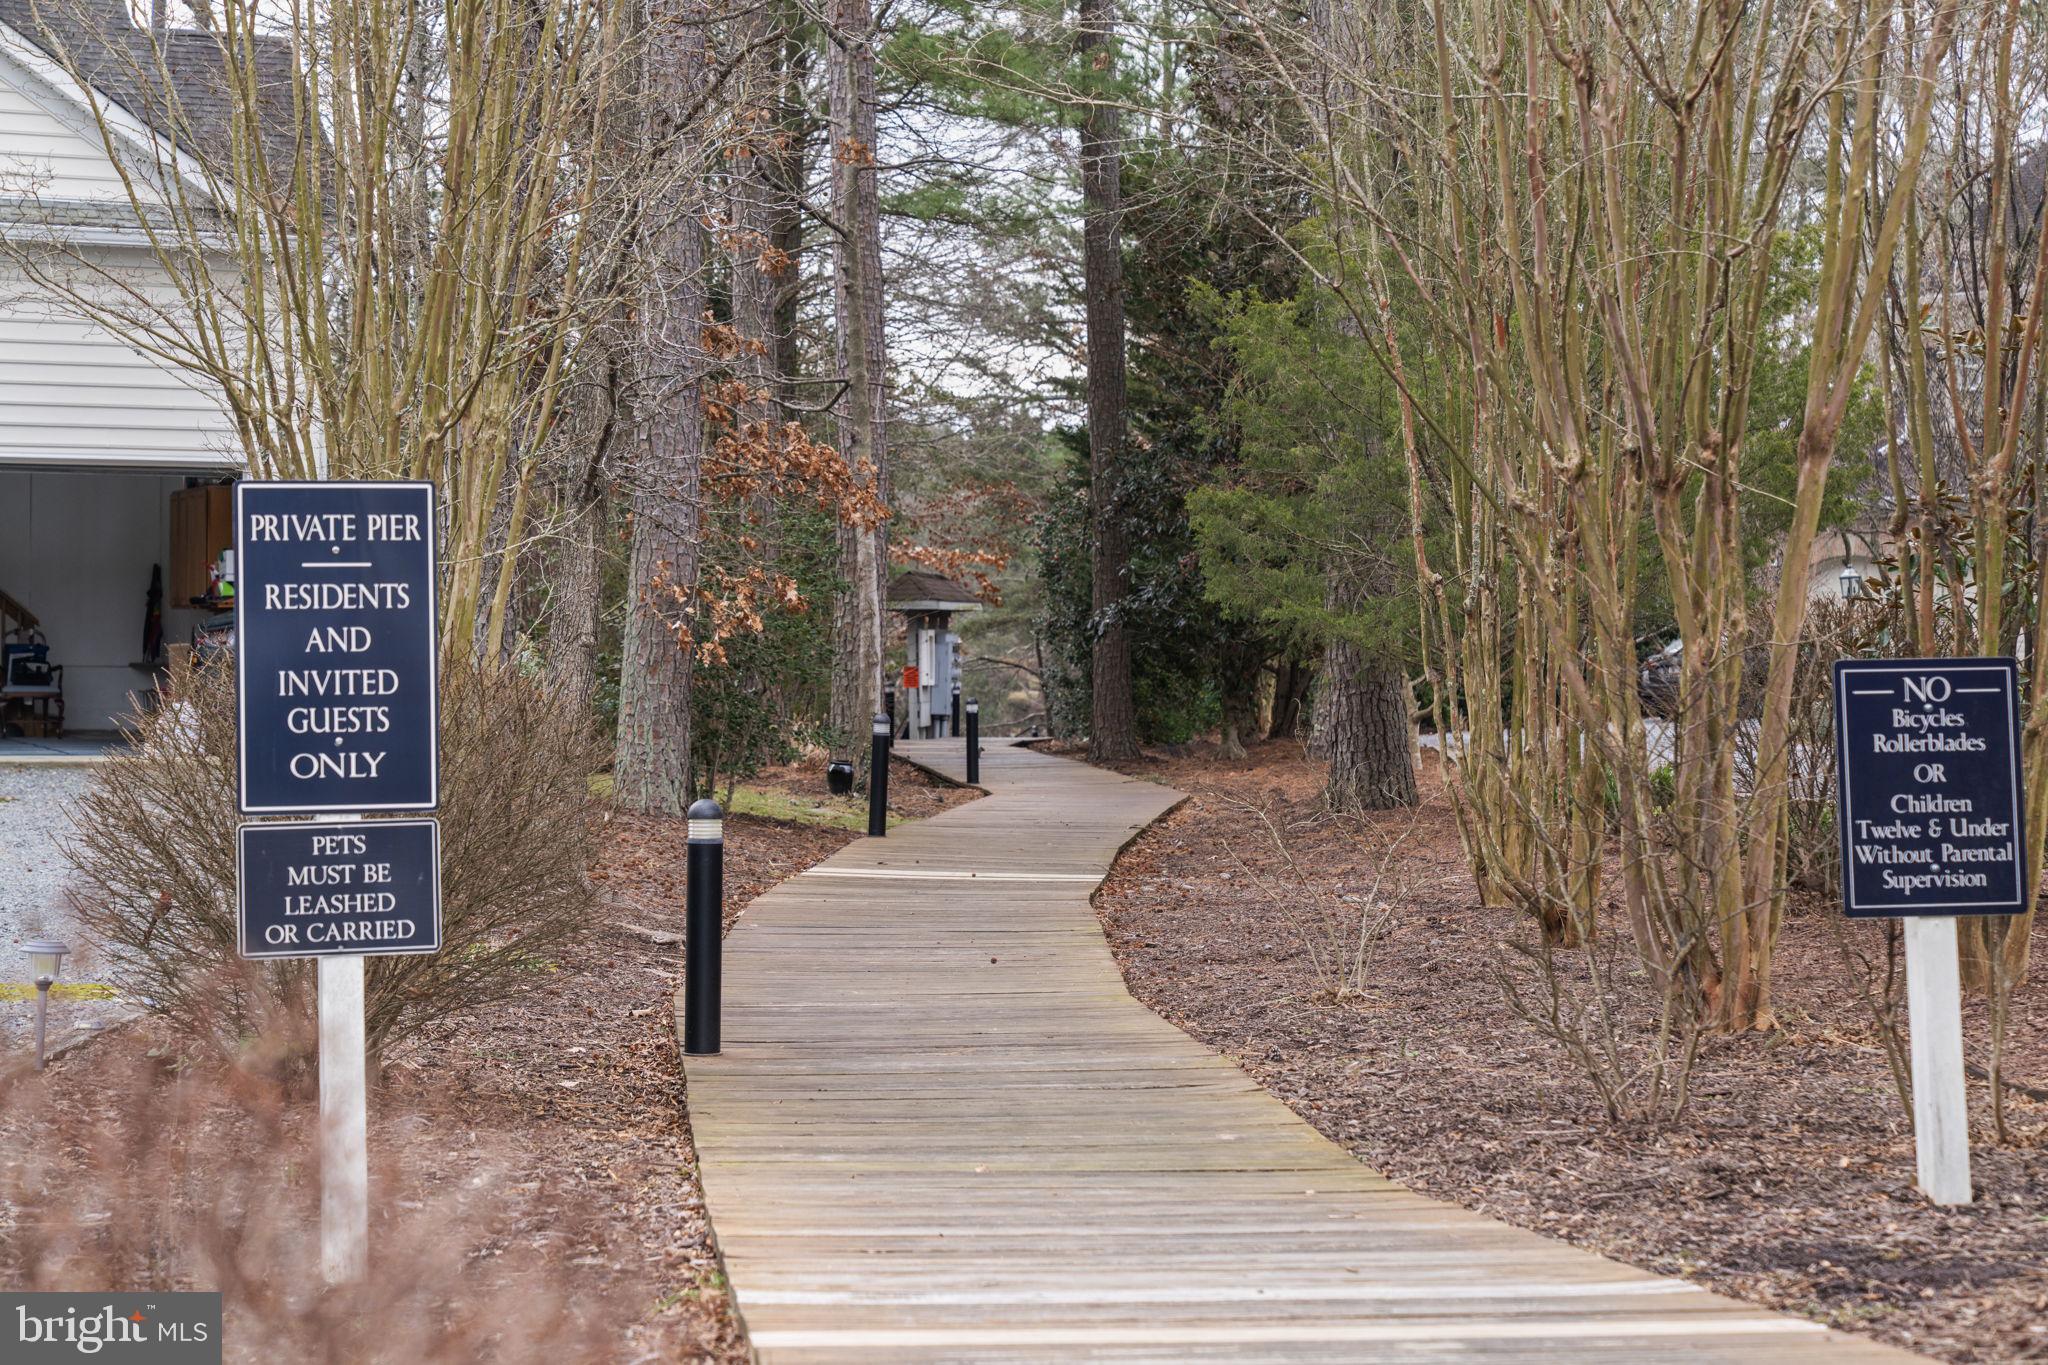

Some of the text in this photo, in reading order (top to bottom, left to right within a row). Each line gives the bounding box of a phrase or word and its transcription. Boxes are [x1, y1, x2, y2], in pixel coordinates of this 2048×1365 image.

[251, 514, 421, 541] PRIVATE PIER
[265, 583, 410, 609] RESIDENTS
[305, 626, 372, 652] AND
[278, 669, 399, 696] INVITED
[1902, 676, 1951, 703] NO
[287, 706, 390, 734] GUESTS
[1892, 708, 1965, 733] Bicycles
[1872, 733, 1986, 753] Rollerblades
[290, 752, 387, 778] ONLY
[1913, 764, 1947, 783] OR
[1890, 794, 1972, 813] Children
[1855, 817, 2009, 839] Twelve & Under
[312, 835, 366, 855] PETS
[1855, 842, 2013, 864] Without Parental
[287, 863, 392, 886] MUST BE
[1882, 869, 1987, 895] Supervision
[284, 892, 396, 915] LEASHED
[265, 920, 416, 944] OR CARRIED
